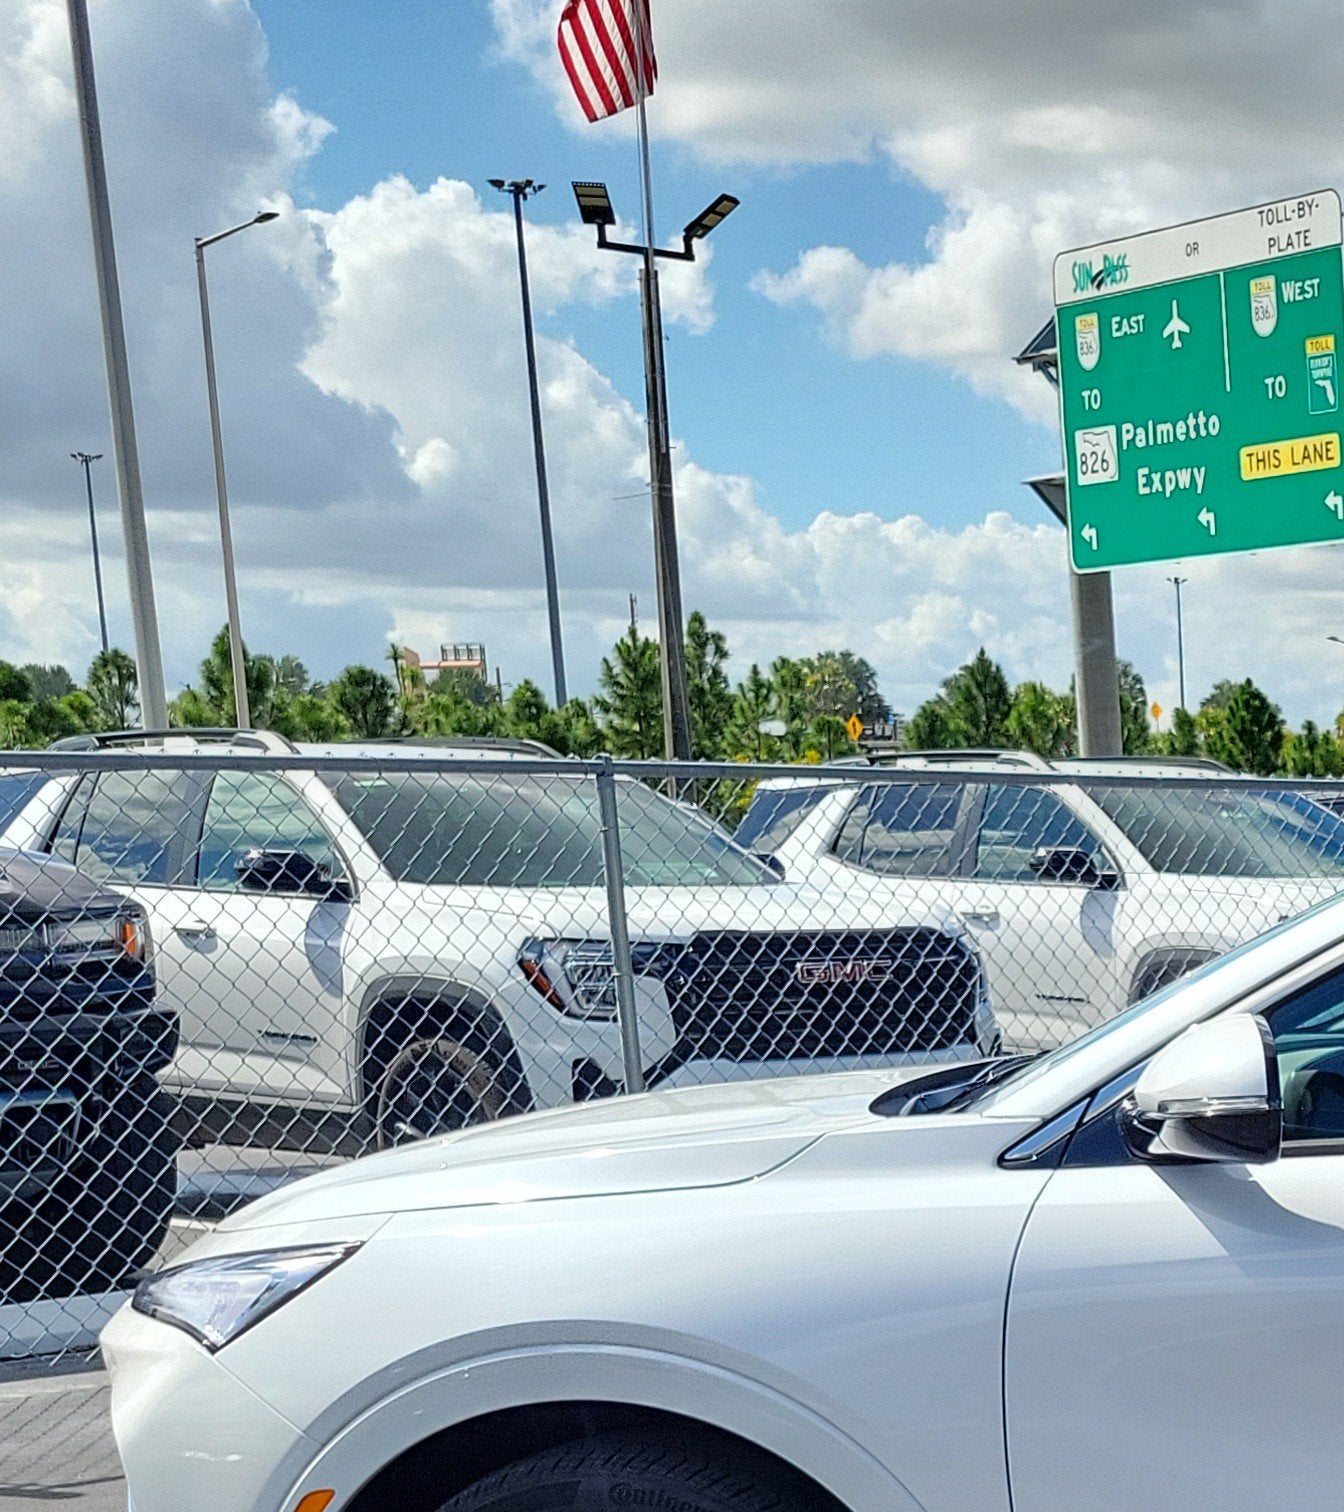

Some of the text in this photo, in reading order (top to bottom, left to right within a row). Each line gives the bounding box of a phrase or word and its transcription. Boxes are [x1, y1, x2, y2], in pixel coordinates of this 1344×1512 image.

[1257, 197, 1320, 228] TOLL-BY-
[1185, 242, 1200, 257] OR
[1267, 229, 1312, 255] PLATE
[1254, 281, 1272, 292] TOLL
[1281, 278, 1320, 304] WEST
[1079, 317, 1095, 328] TOLL
[1254, 304, 1271, 322] 836
[1111, 314, 1145, 338] EAST
[1080, 340, 1094, 356] 836
[1309, 340, 1331, 351] TOLL
[1081, 388, 1101, 411] TO
[1264, 375, 1286, 400] TO
[1121, 410, 1220, 451] Palmetto
[1080, 450, 1110, 476] 826
[1246, 440, 1335, 473] THIS LANE
[1137, 466, 1206, 498] Expwy
[796, 960, 893, 984] GMC
